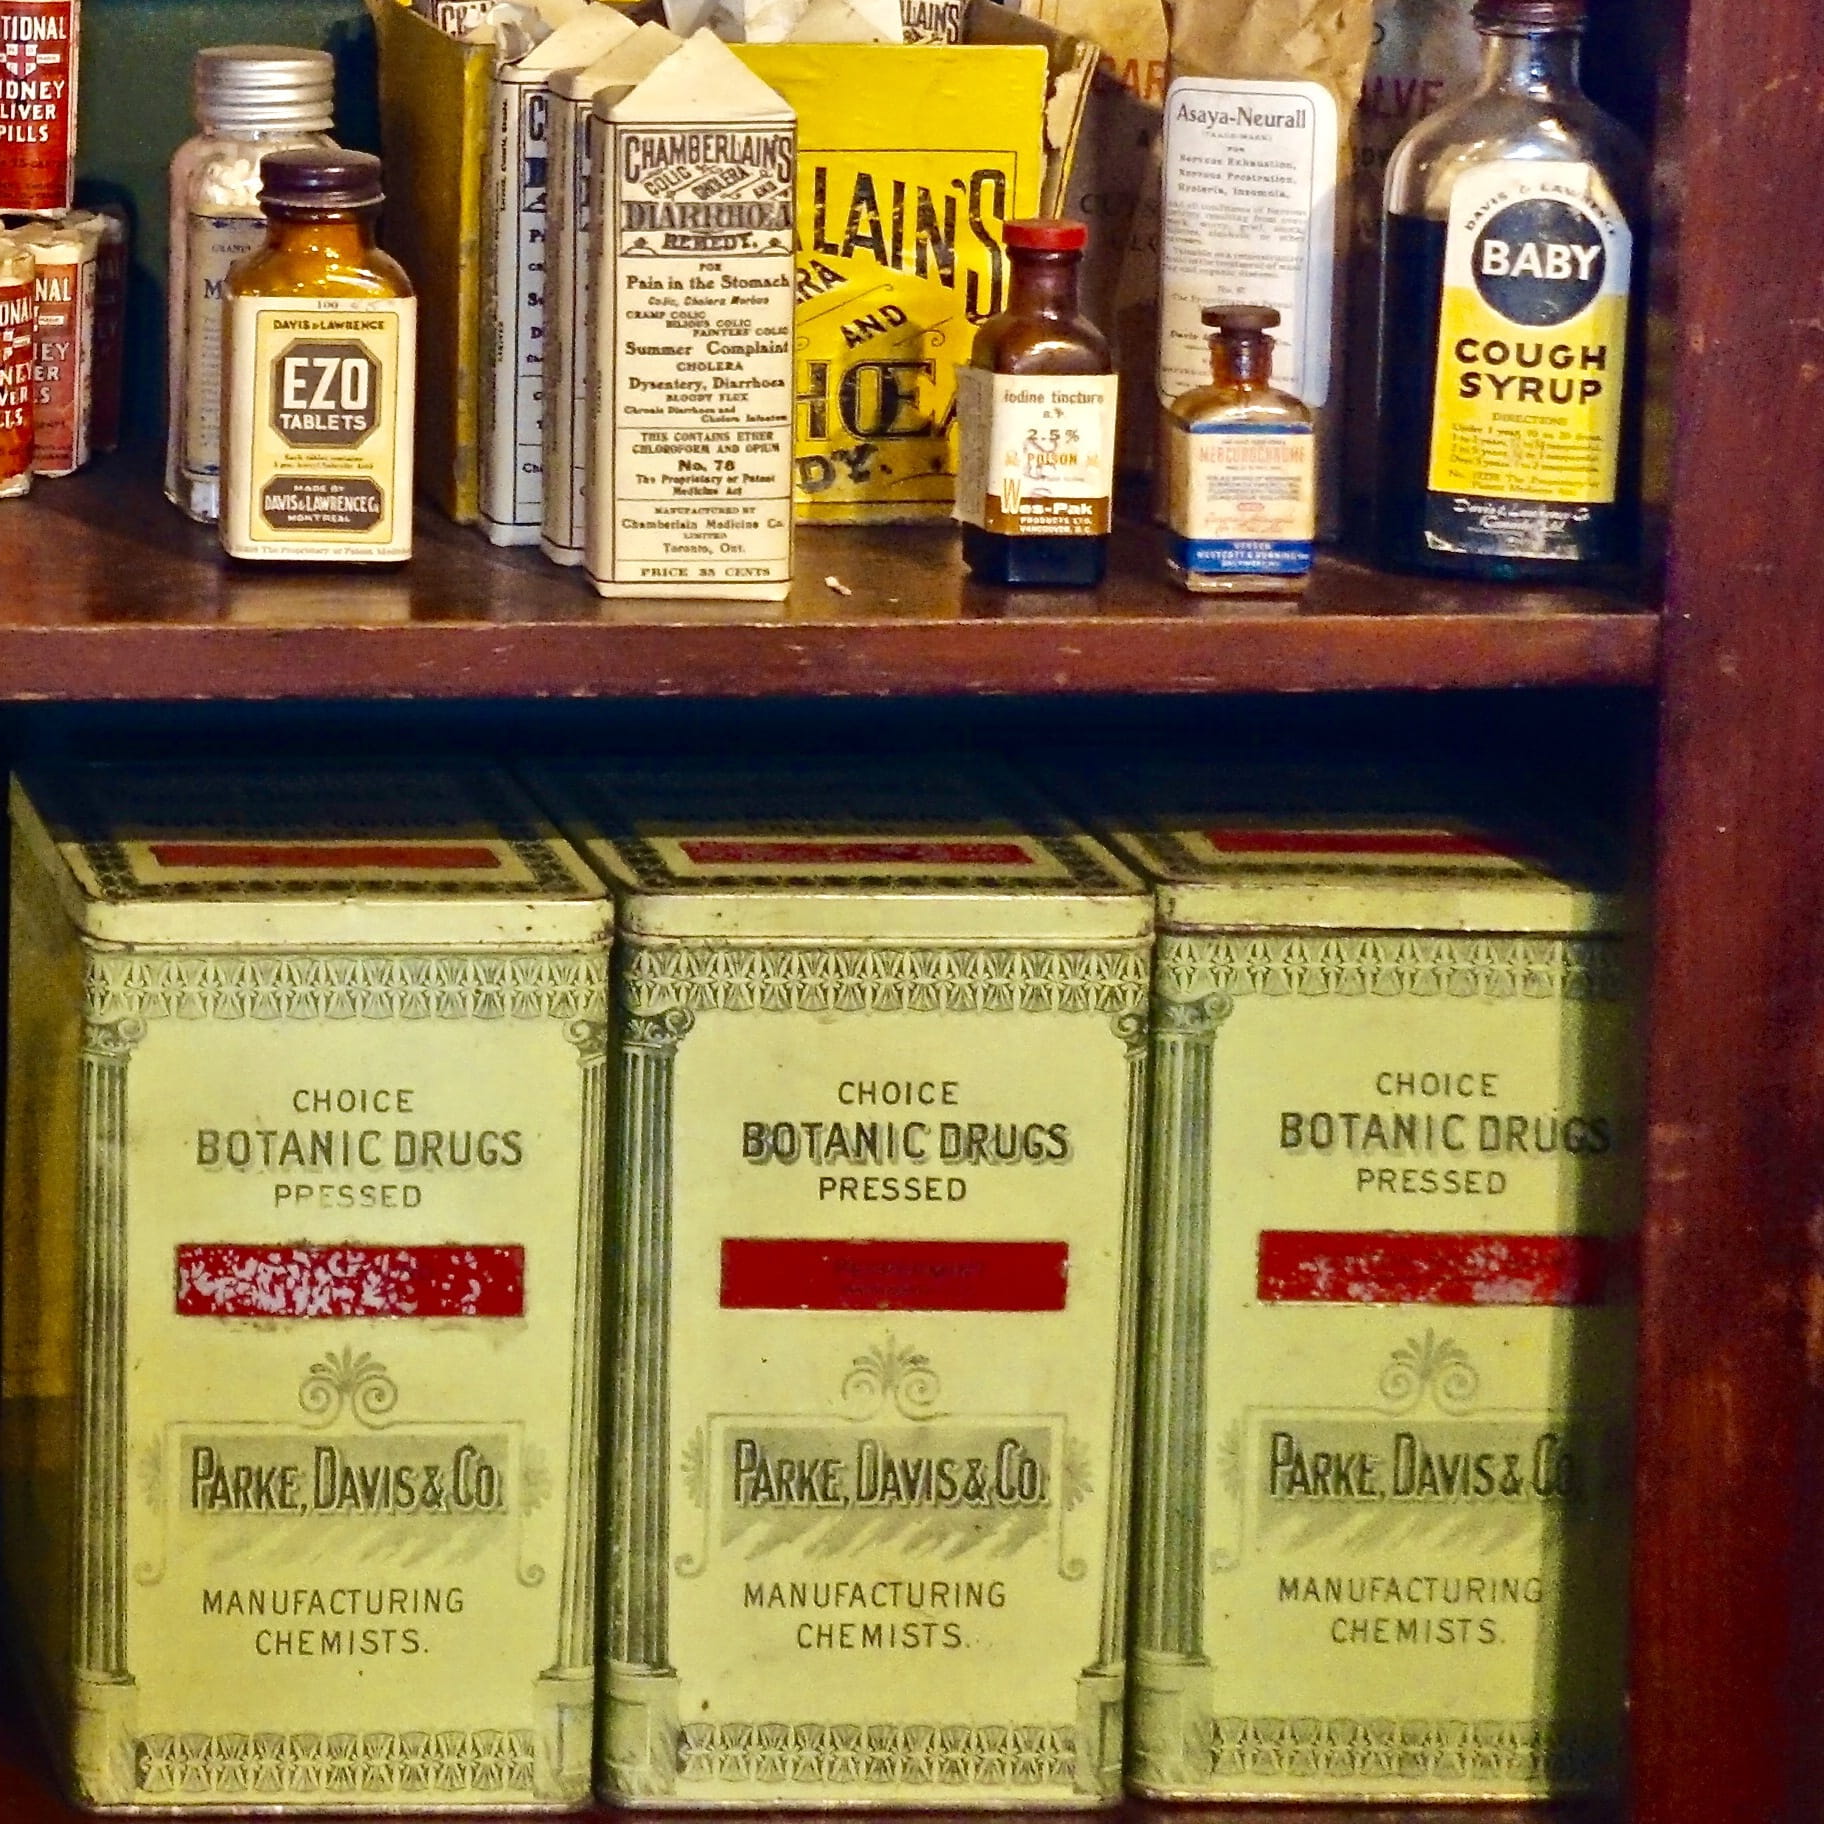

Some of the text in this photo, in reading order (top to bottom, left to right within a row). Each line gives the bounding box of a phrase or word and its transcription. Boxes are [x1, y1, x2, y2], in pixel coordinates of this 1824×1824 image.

[1480, 239, 1602, 281] BABY
[626, 275, 790, 289] Pain the Stomach
[624, 341, 789, 357] Summer Complaint
[1454, 337, 1608, 373] COUGH
[283, 357, 369, 411] EZO
[1458, 369, 1604, 403] SYRUP
[280, 413, 367, 431] TABLETS
[292, 1087, 415, 1115] CHOICE
[1277, 1109, 1612, 1155] BOTANIC DRUGS
[195, 1128, 525, 1170] BOTANIC DRUGS
[201, 1587, 465, 1617] MANUFACTURING
[253, 1628, 431, 1657] CHEMISTS.
